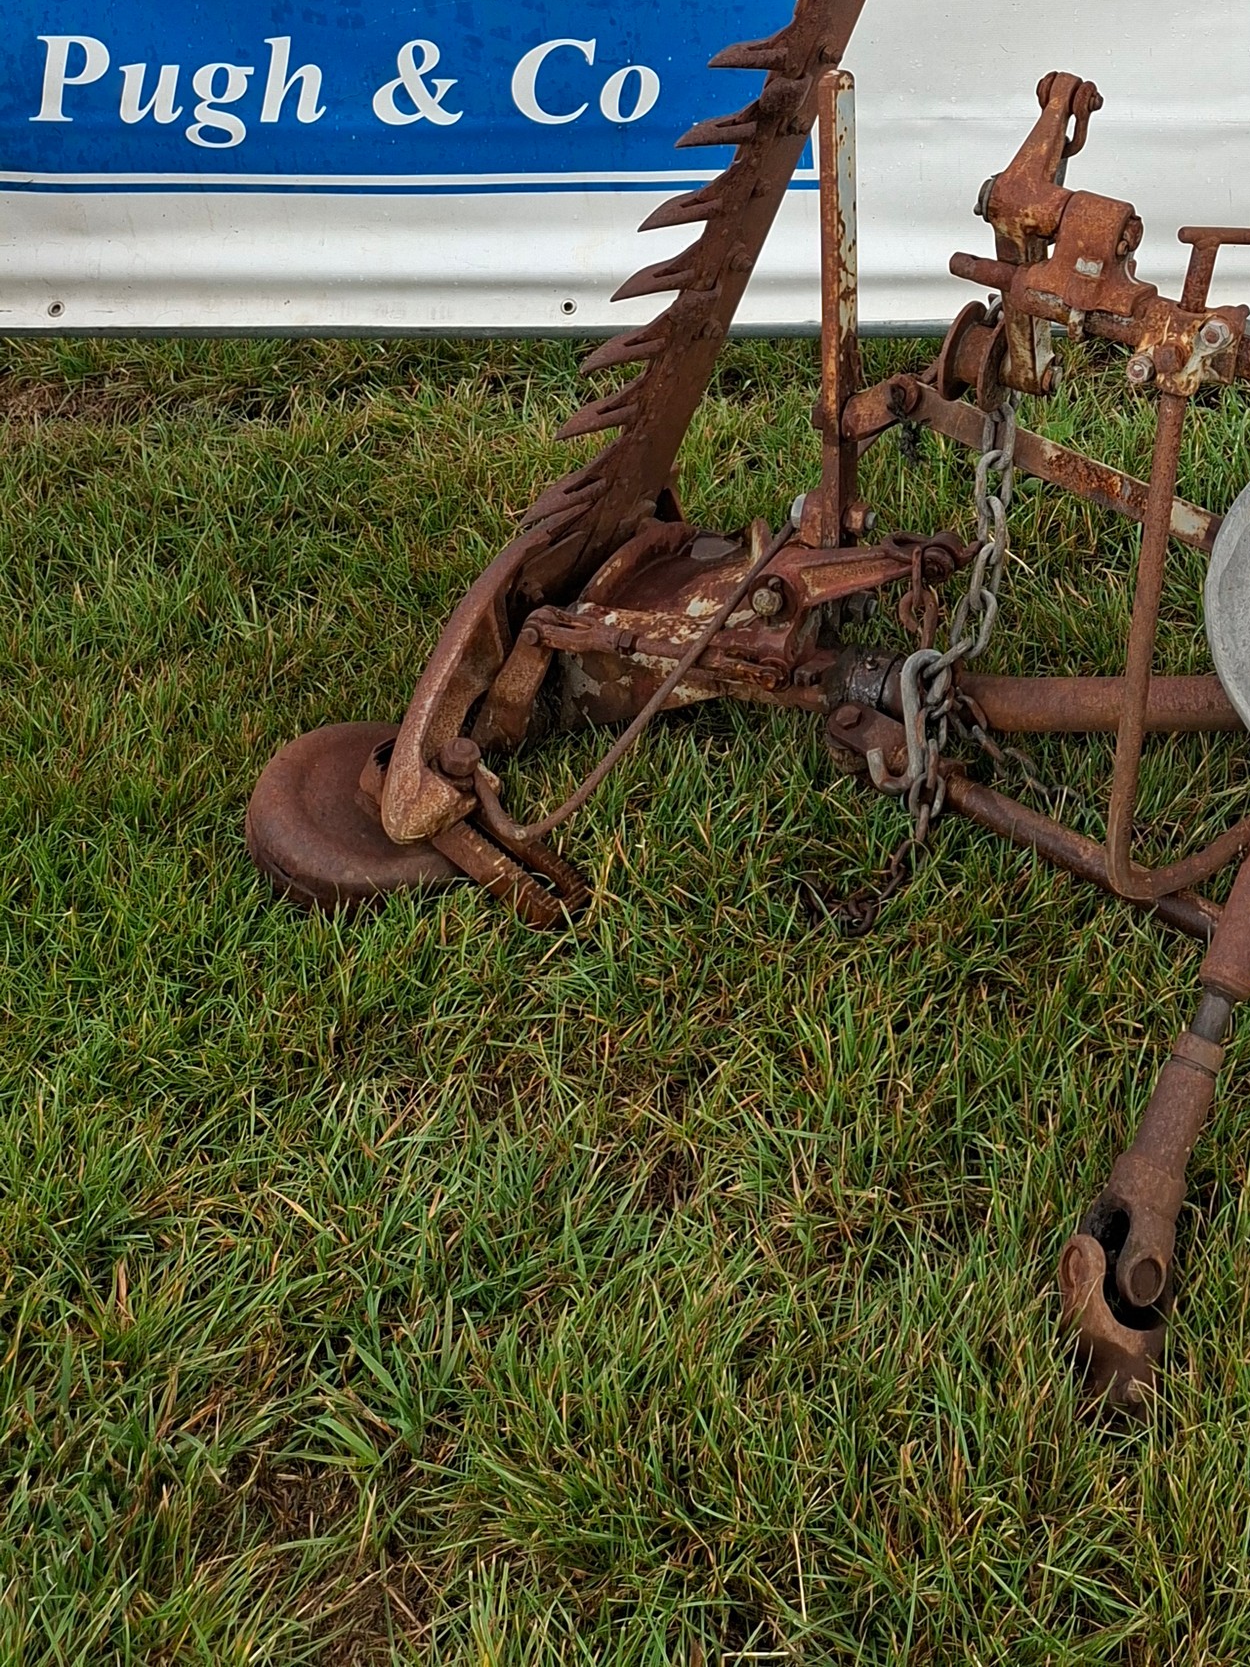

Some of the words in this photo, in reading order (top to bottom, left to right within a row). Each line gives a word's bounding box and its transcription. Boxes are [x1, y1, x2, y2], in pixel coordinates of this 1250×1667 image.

[32, 35, 326, 148] Pugh
[372, 39, 463, 126] &
[511, 38, 660, 125] Co
